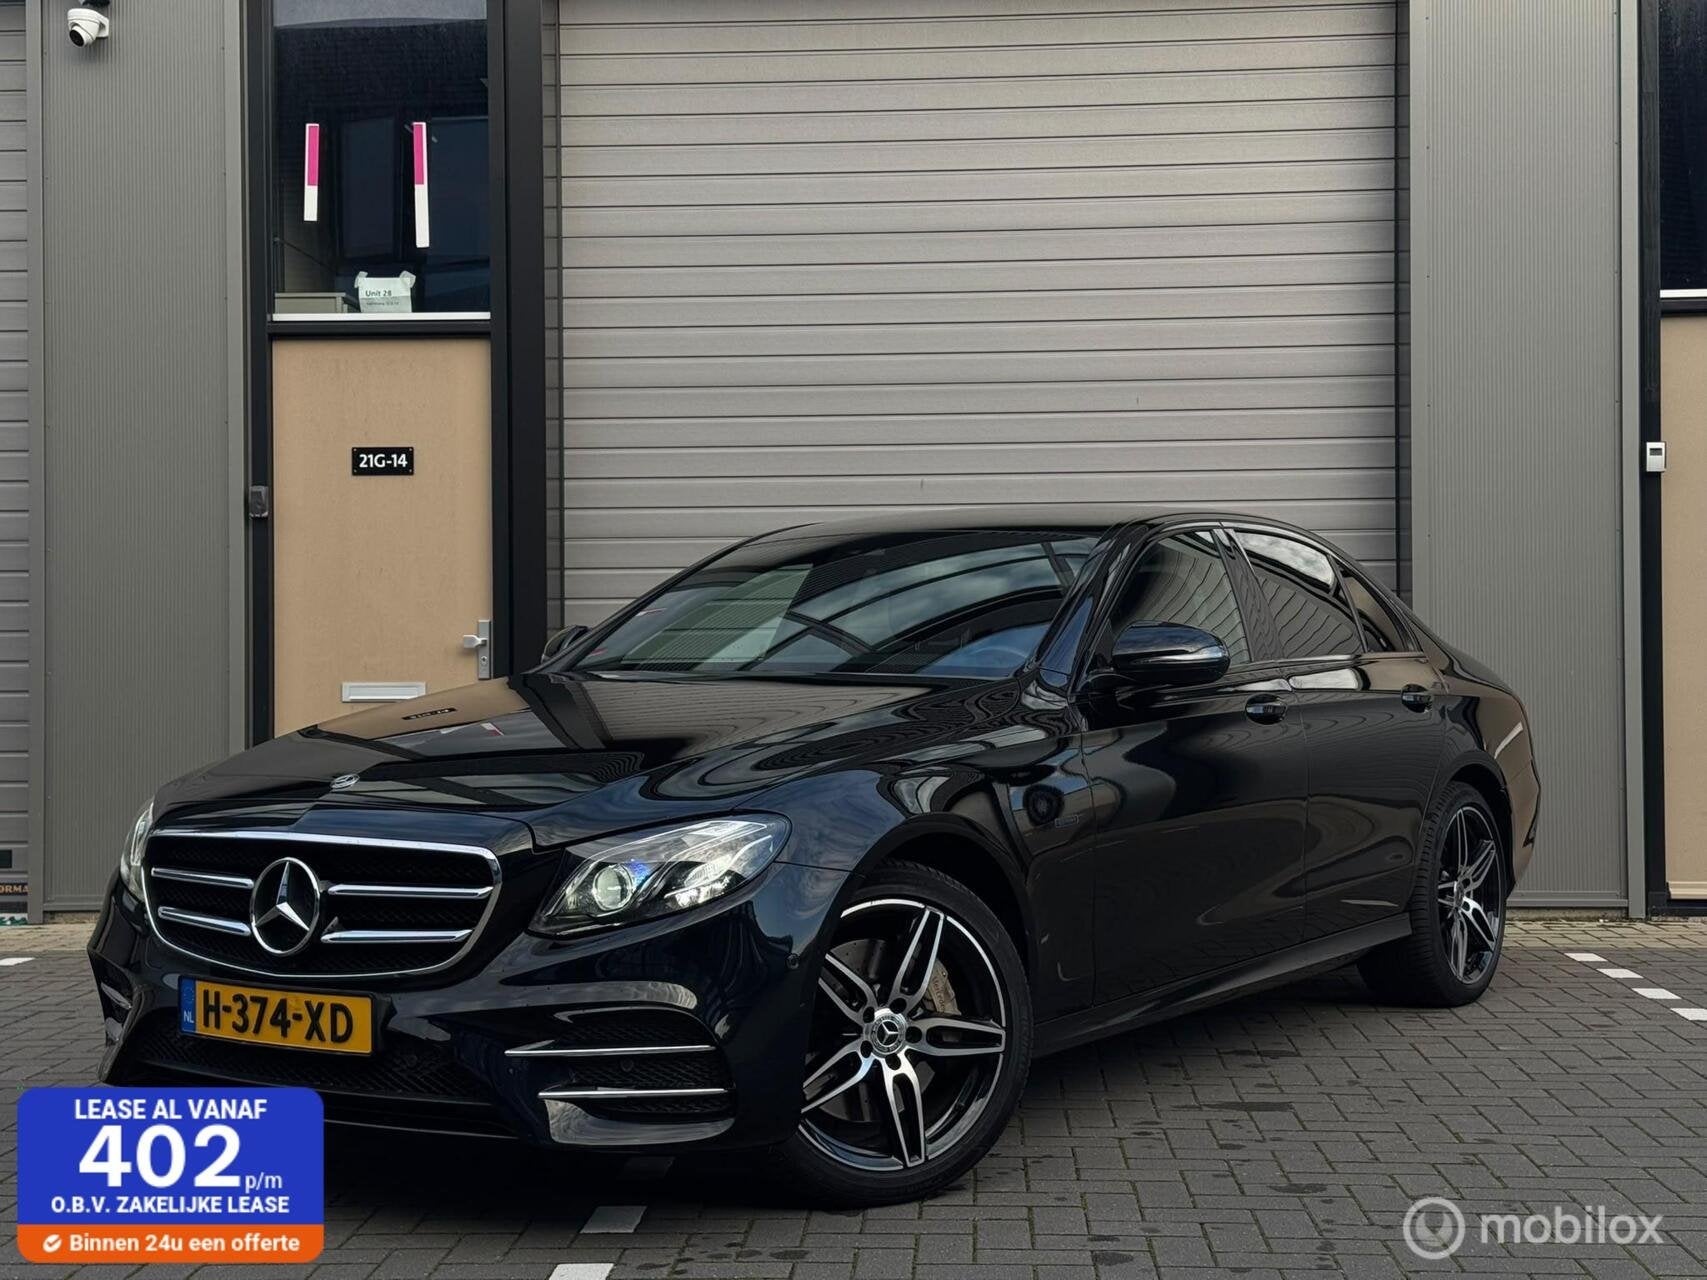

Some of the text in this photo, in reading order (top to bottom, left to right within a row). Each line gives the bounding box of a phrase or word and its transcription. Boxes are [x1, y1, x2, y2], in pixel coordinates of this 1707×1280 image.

[359, 453, 408, 468] 21G-14
[183, 1010, 195, 1024] NL
[203, 989, 353, 1043] H-374-XD
